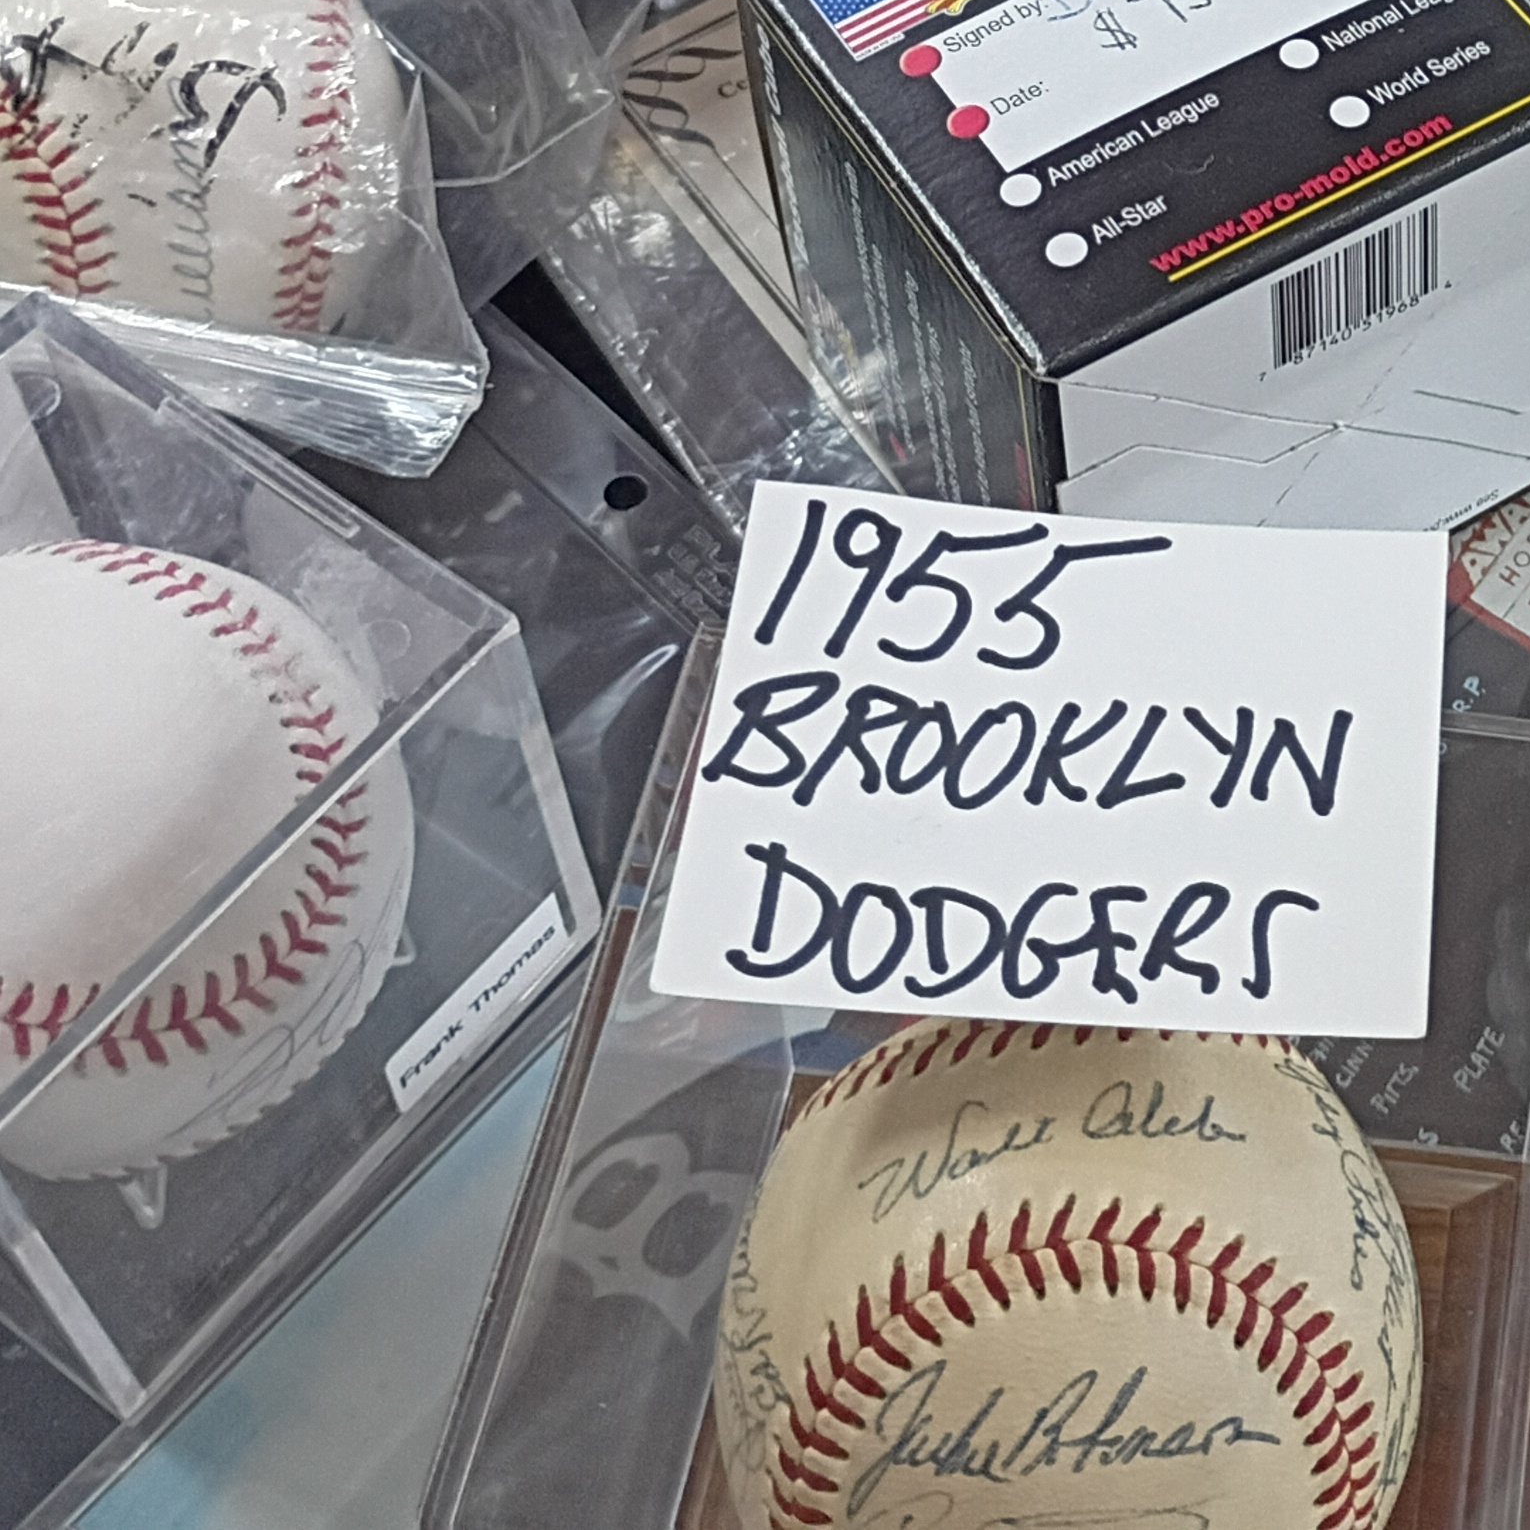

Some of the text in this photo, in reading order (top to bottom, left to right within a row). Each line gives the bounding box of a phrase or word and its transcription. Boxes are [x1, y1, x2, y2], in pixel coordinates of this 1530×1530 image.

[943, 11, 1012, 54] Signed
[1322, 5, 1403, 54] National
[989, 81, 1050, 119] Date:
[1365, 37, 1492, 108] World Series
[1047, 89, 1221, 188] American League
[1088, 192, 1168, 247] All-Star
[1148, 110, 1455, 274] www.pro-mold.com
[754, 497, 1173, 670] 1955
[702, 671, 1353, 816] BROOKLYN
[725, 841, 1320, 1004] DODGERS
[399, 925, 556, 1090] Frank Thomas
[1451, 1025, 1506, 1094] PLATE
